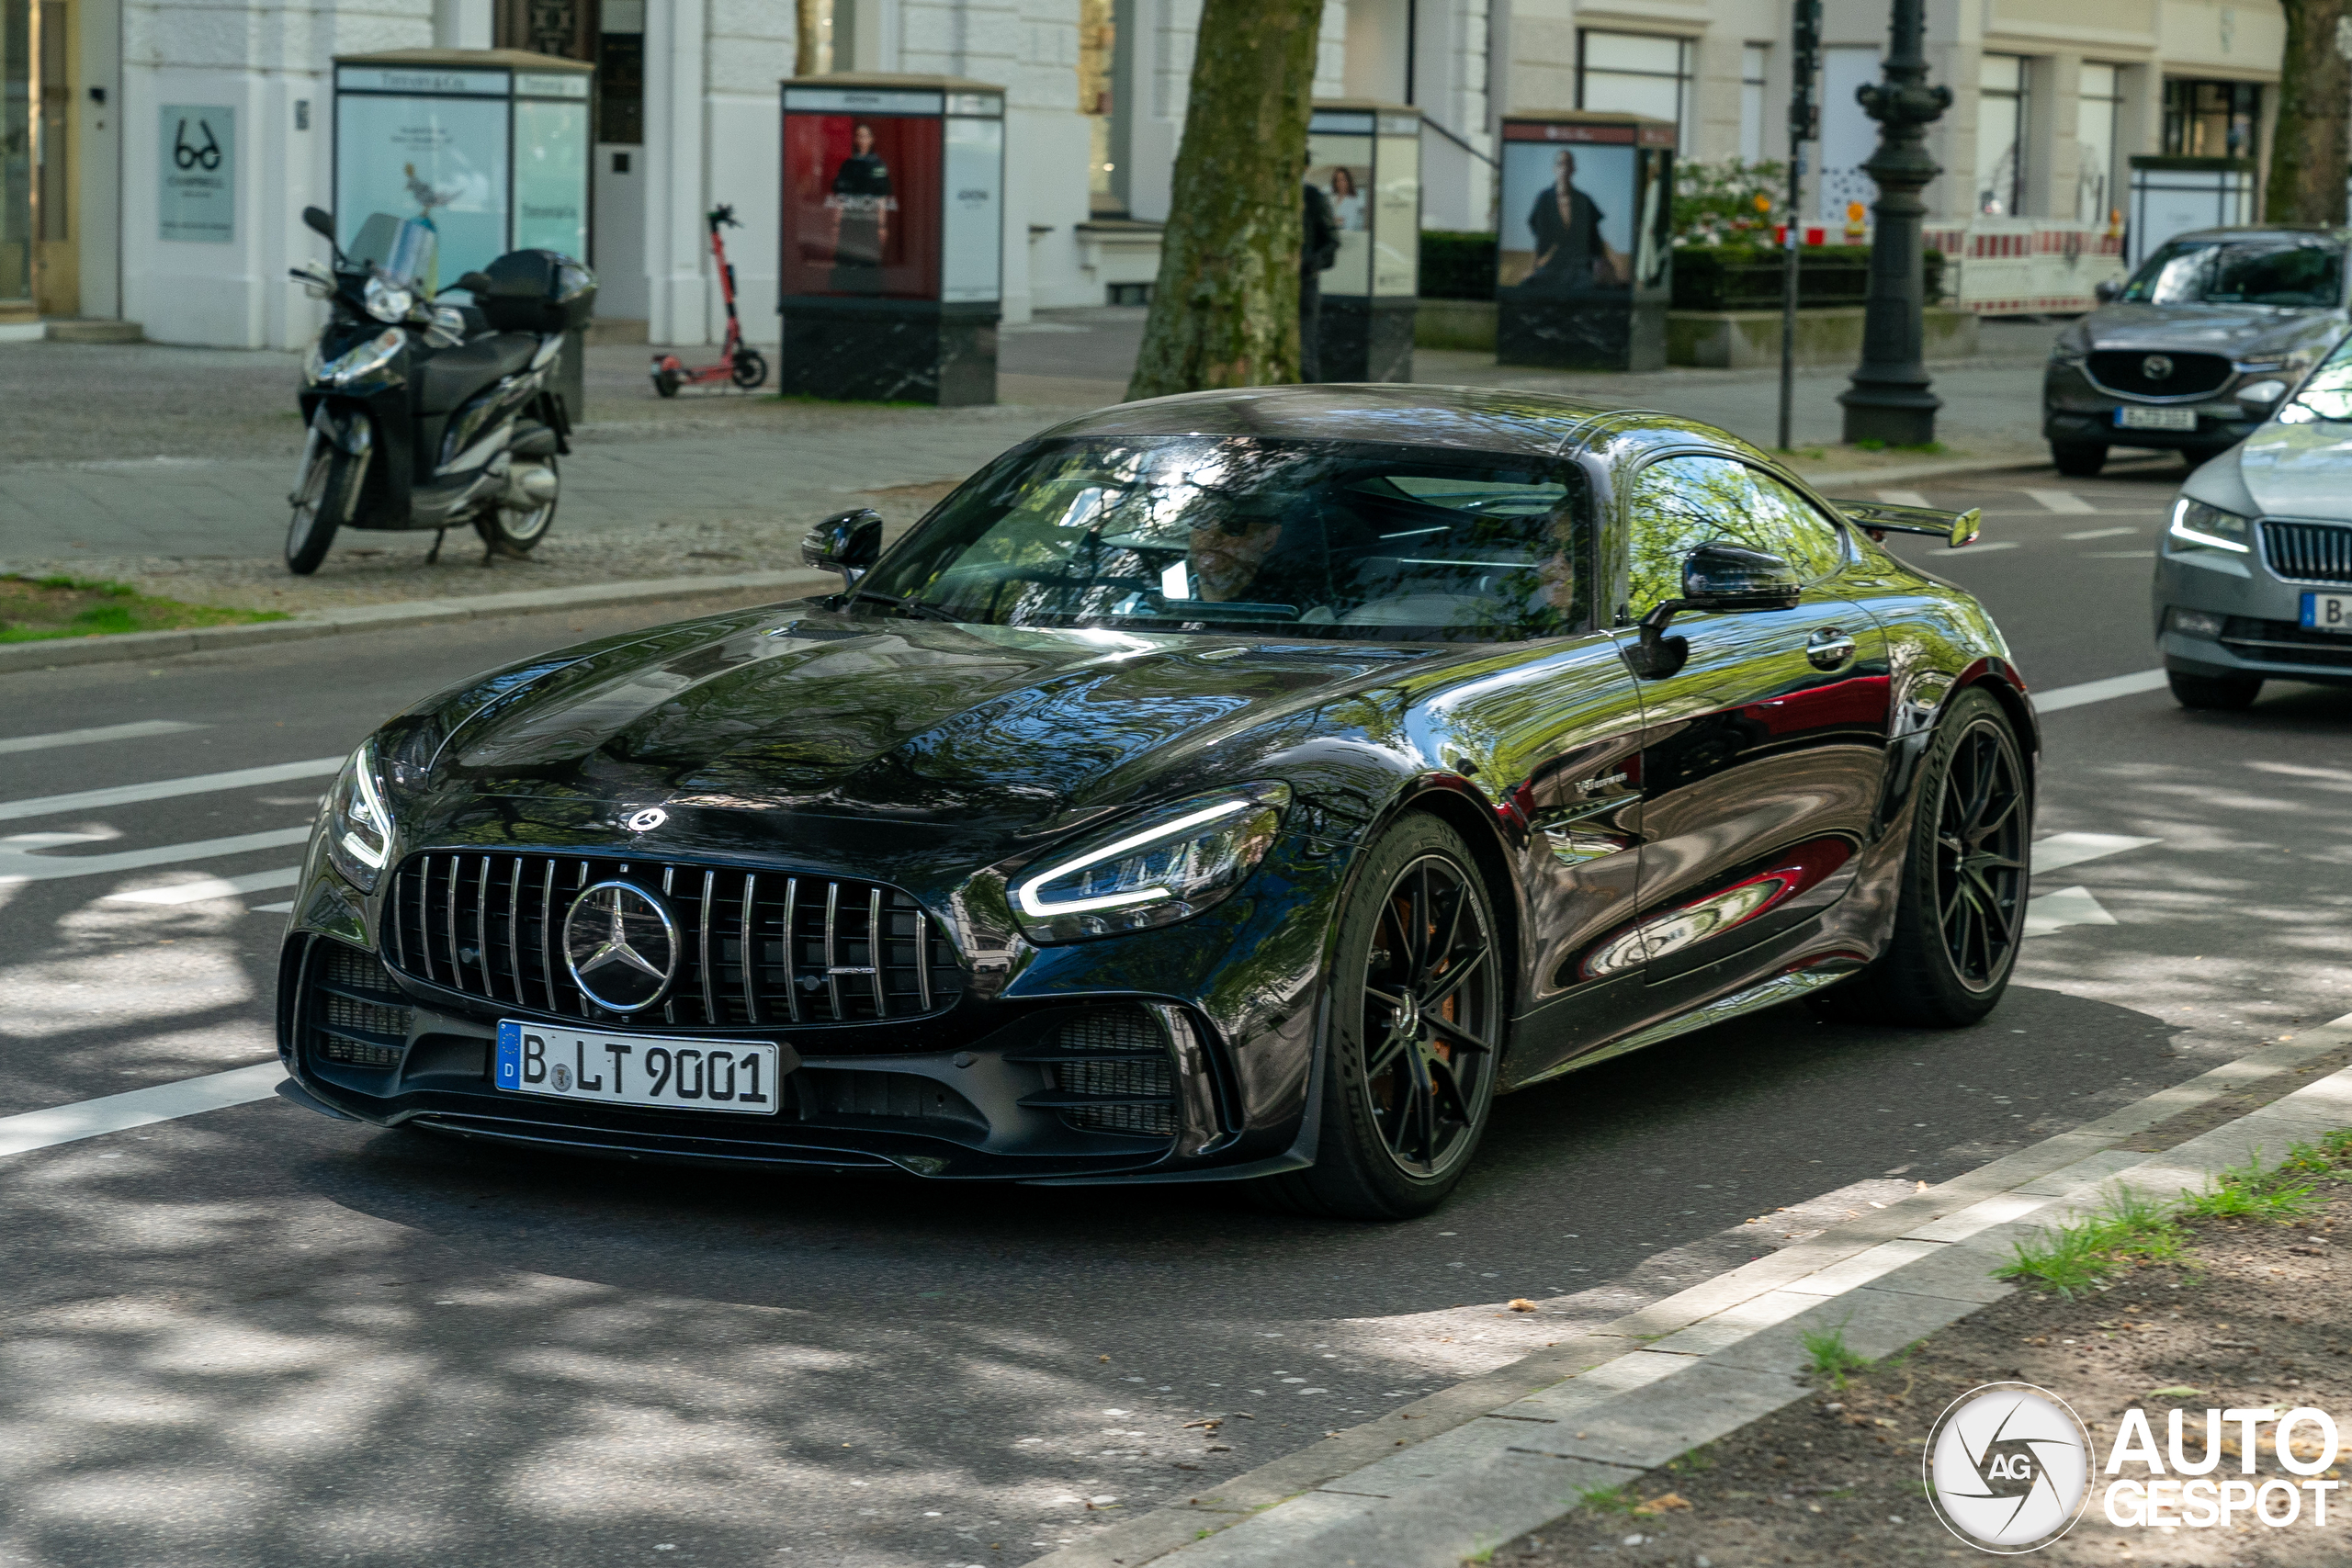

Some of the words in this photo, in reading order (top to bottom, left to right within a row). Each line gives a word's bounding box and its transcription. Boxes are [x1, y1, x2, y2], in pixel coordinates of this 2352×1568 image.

[2327, 600, 2342, 623] B
[505, 1064, 514, 1077] D
[524, 1034, 546, 1083] B
[577, 1041, 632, 1093] LT
[646, 1047, 768, 1102] 9001
